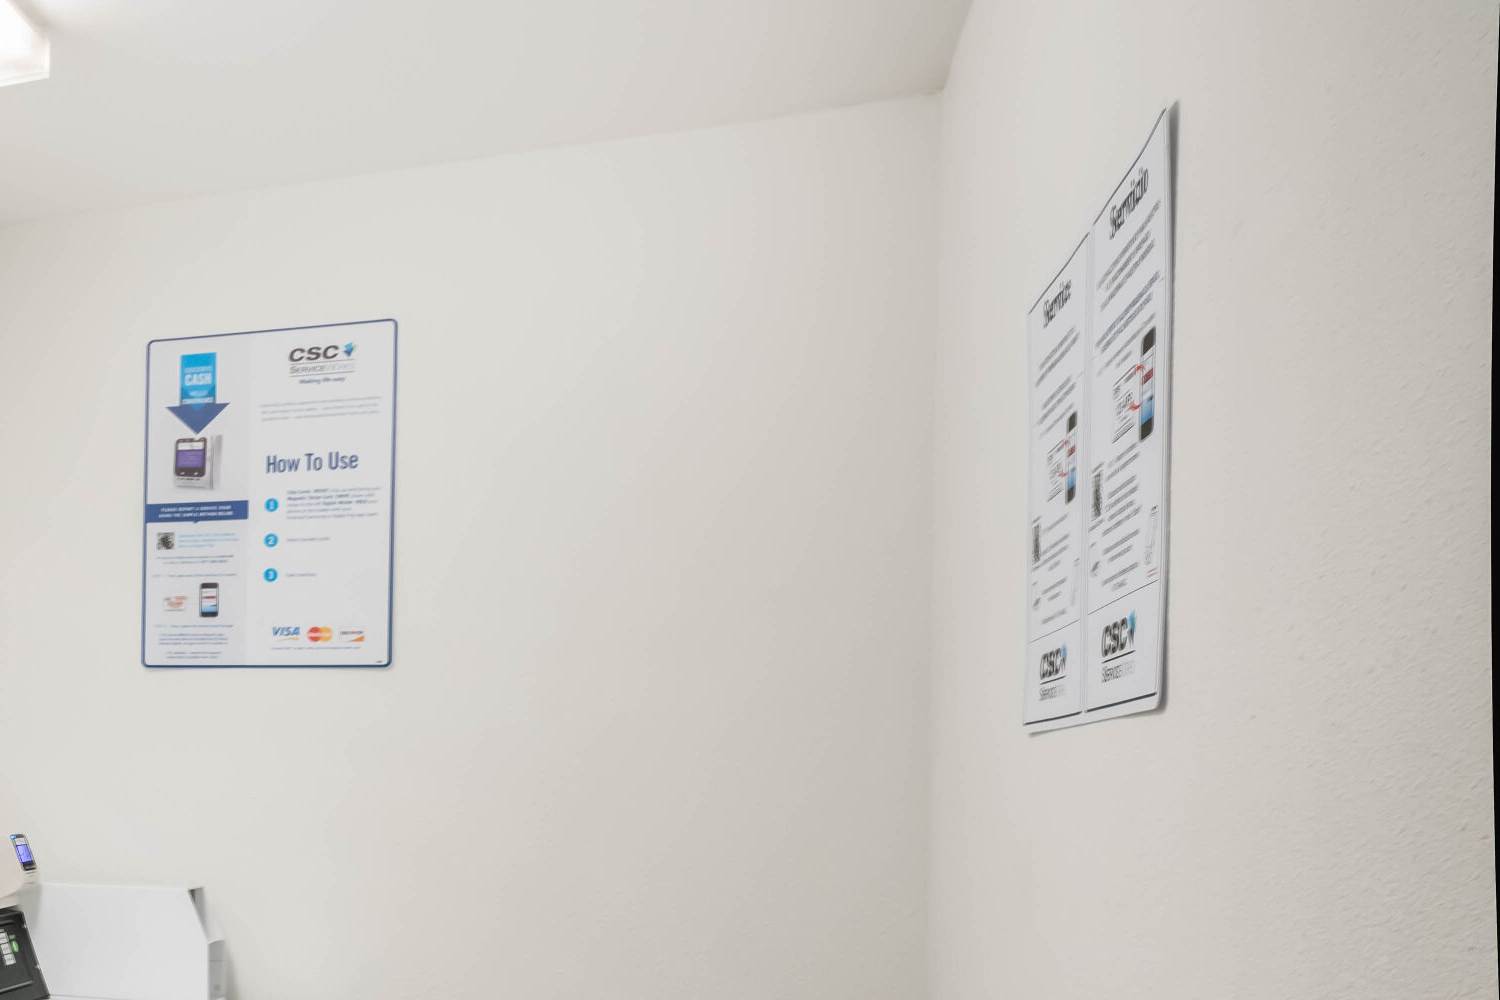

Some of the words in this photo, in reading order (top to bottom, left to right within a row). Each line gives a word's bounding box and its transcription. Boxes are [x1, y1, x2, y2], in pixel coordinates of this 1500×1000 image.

[289, 344, 340, 362] CSC
[185, 373, 212, 386] CASH
[266, 454, 300, 473] How
[304, 452, 323, 471] To
[328, 451, 359, 470] Use
[272, 626, 300, 636] VISA
[1101, 617, 1128, 657] CSC
[1040, 648, 1061, 680] CSC
